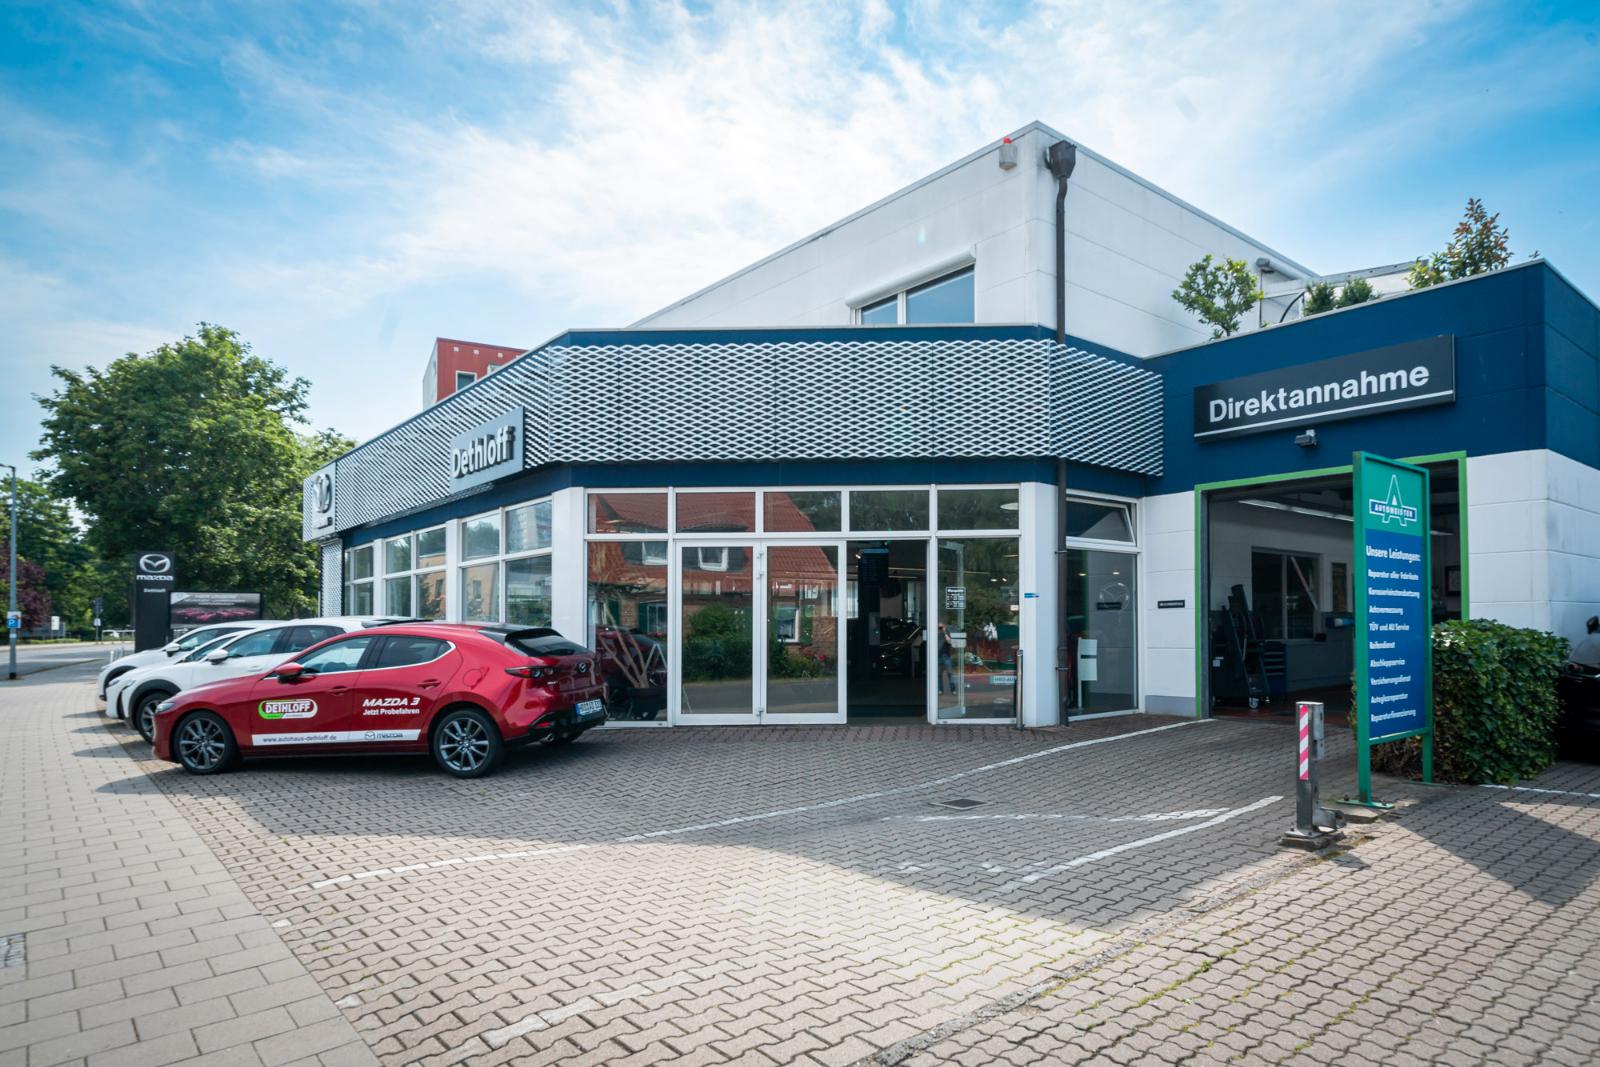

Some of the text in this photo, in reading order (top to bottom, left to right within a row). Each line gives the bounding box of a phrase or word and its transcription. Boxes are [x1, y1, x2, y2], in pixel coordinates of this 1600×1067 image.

[1209, 365, 1430, 424] Direktannahme
[451, 425, 514, 478] Dethloff
[1365, 545, 1421, 563] Unsere Leistungen:
[265, 701, 310, 714] DETHLOFF
[362, 697, 421, 707] MAZDA 3
[362, 708, 420, 716] Jetzt Probefahren
